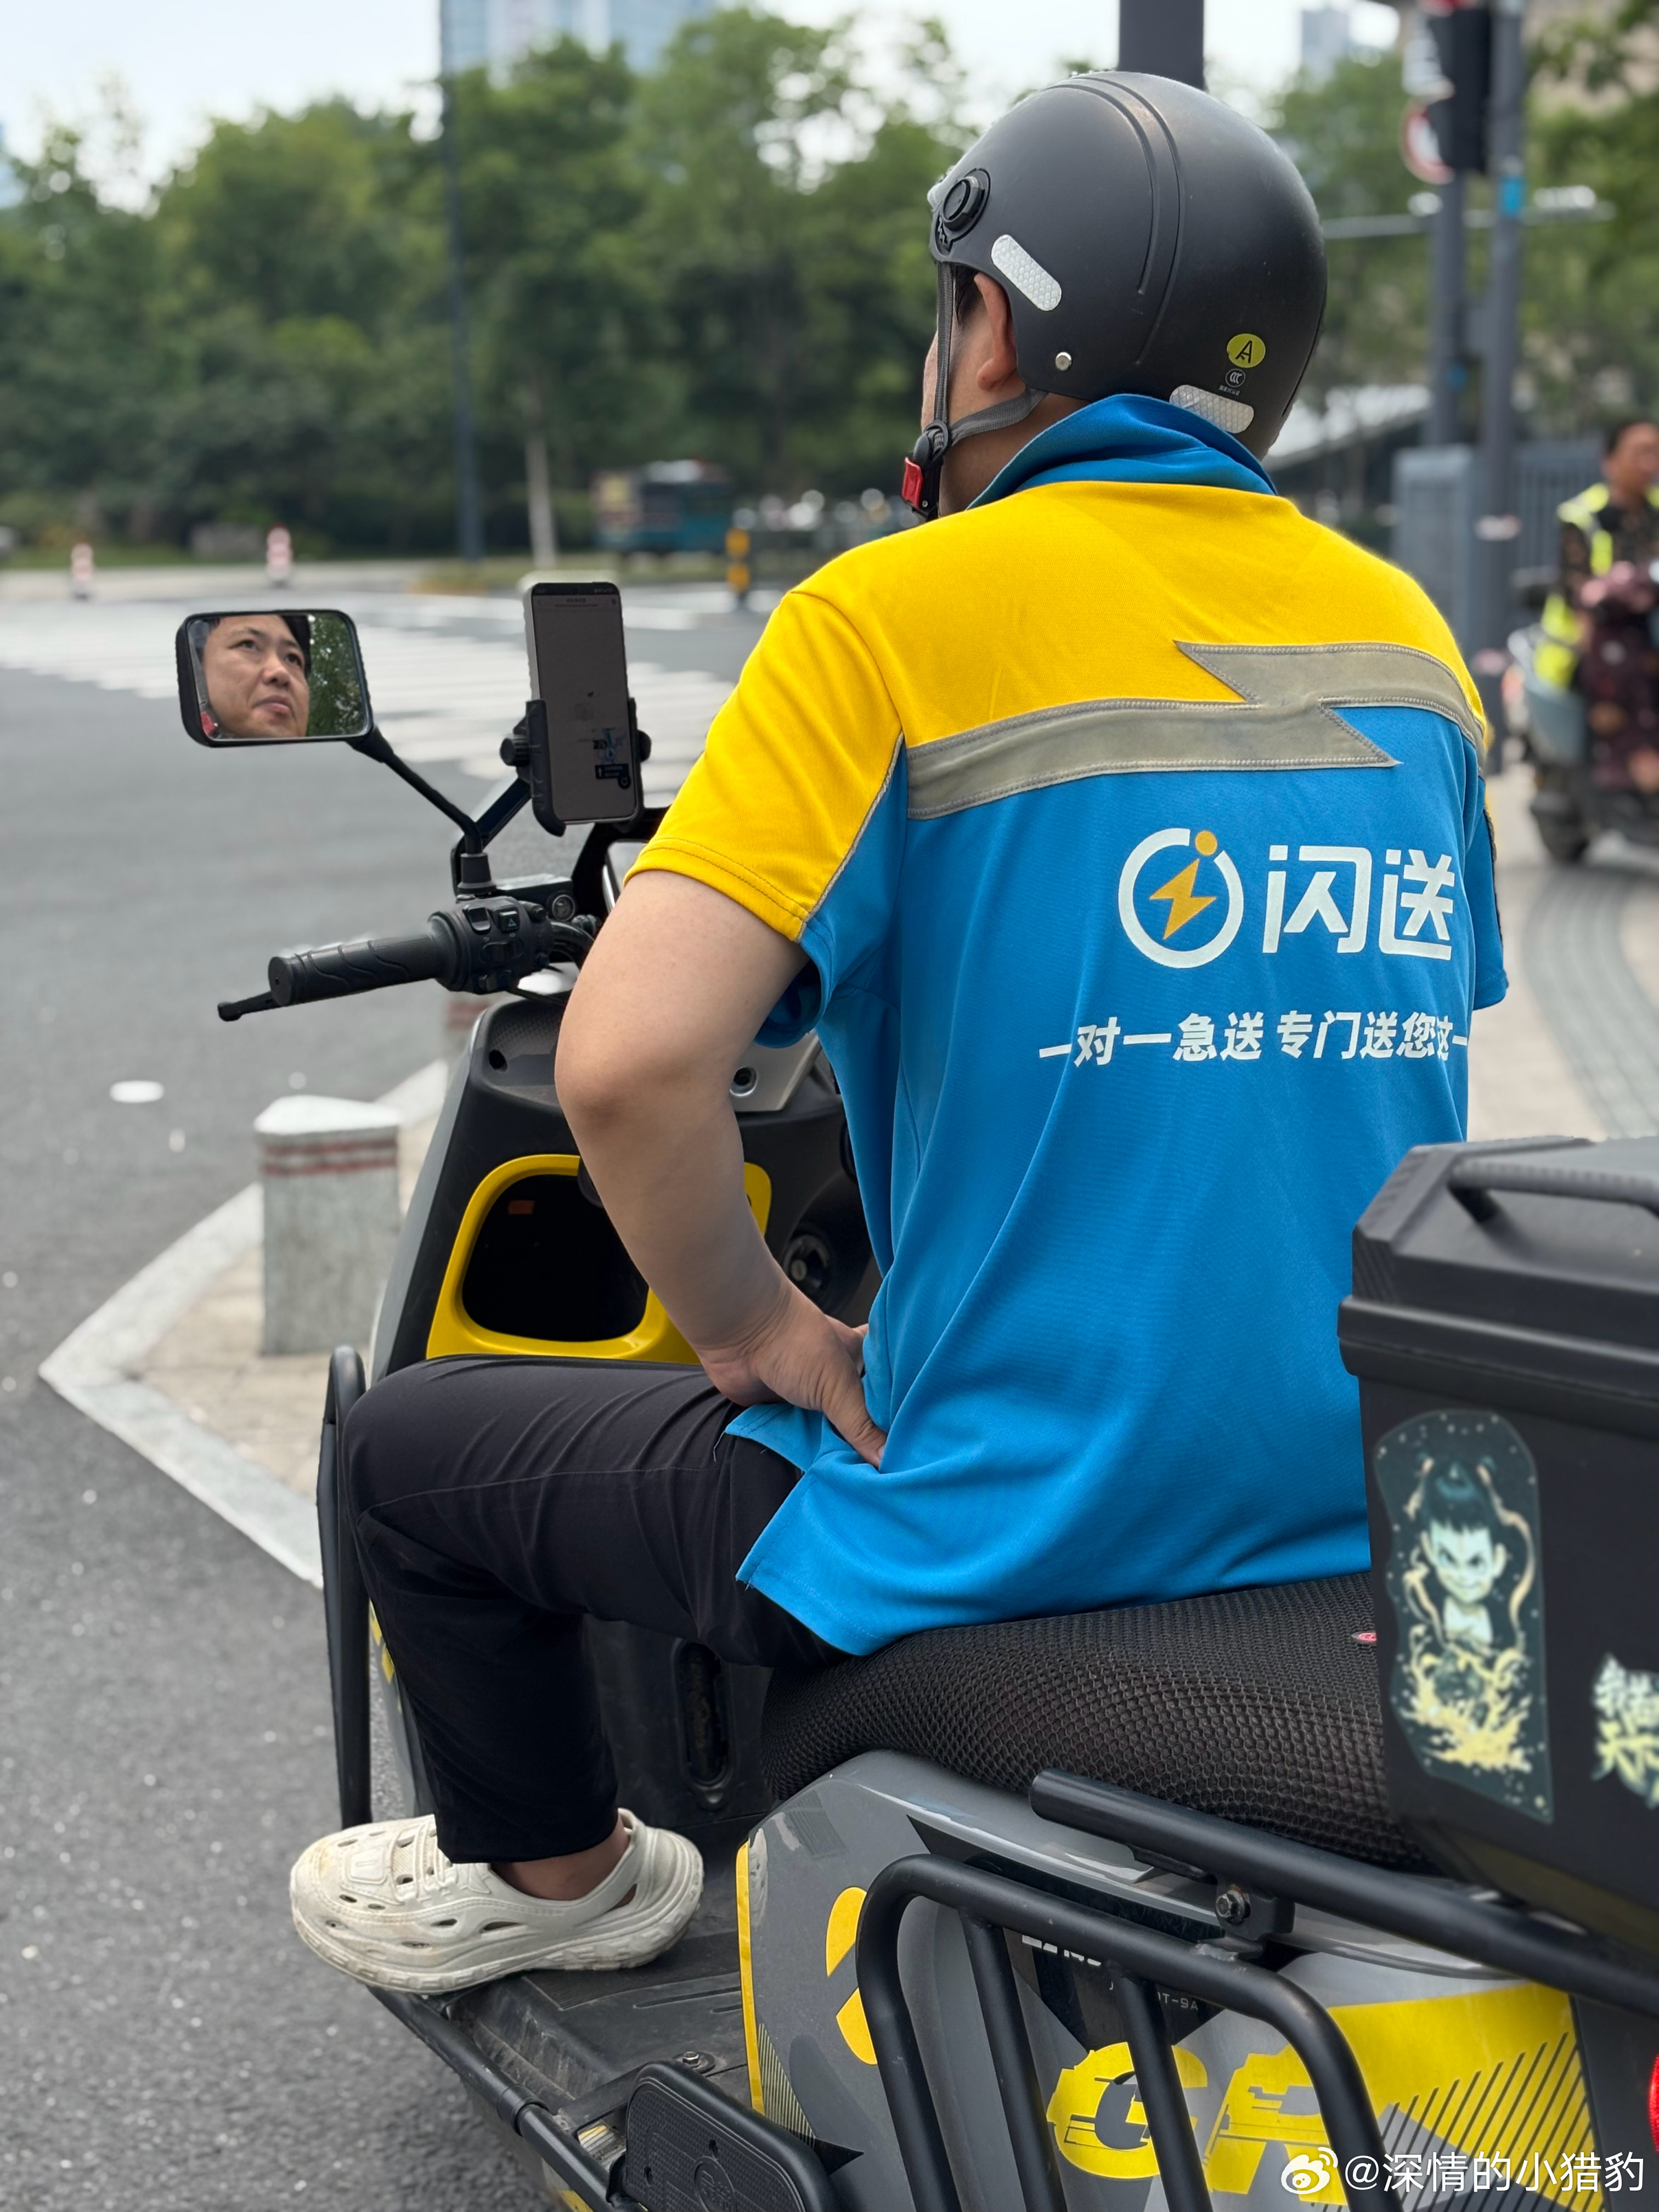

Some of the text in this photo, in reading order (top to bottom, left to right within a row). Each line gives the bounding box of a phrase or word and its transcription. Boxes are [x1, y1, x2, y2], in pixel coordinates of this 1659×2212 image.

[1235, 340, 1253, 363] A
[1262, 844, 1455, 961] 闪送
[1039, 1012, 1263, 1066] 一对一急送
